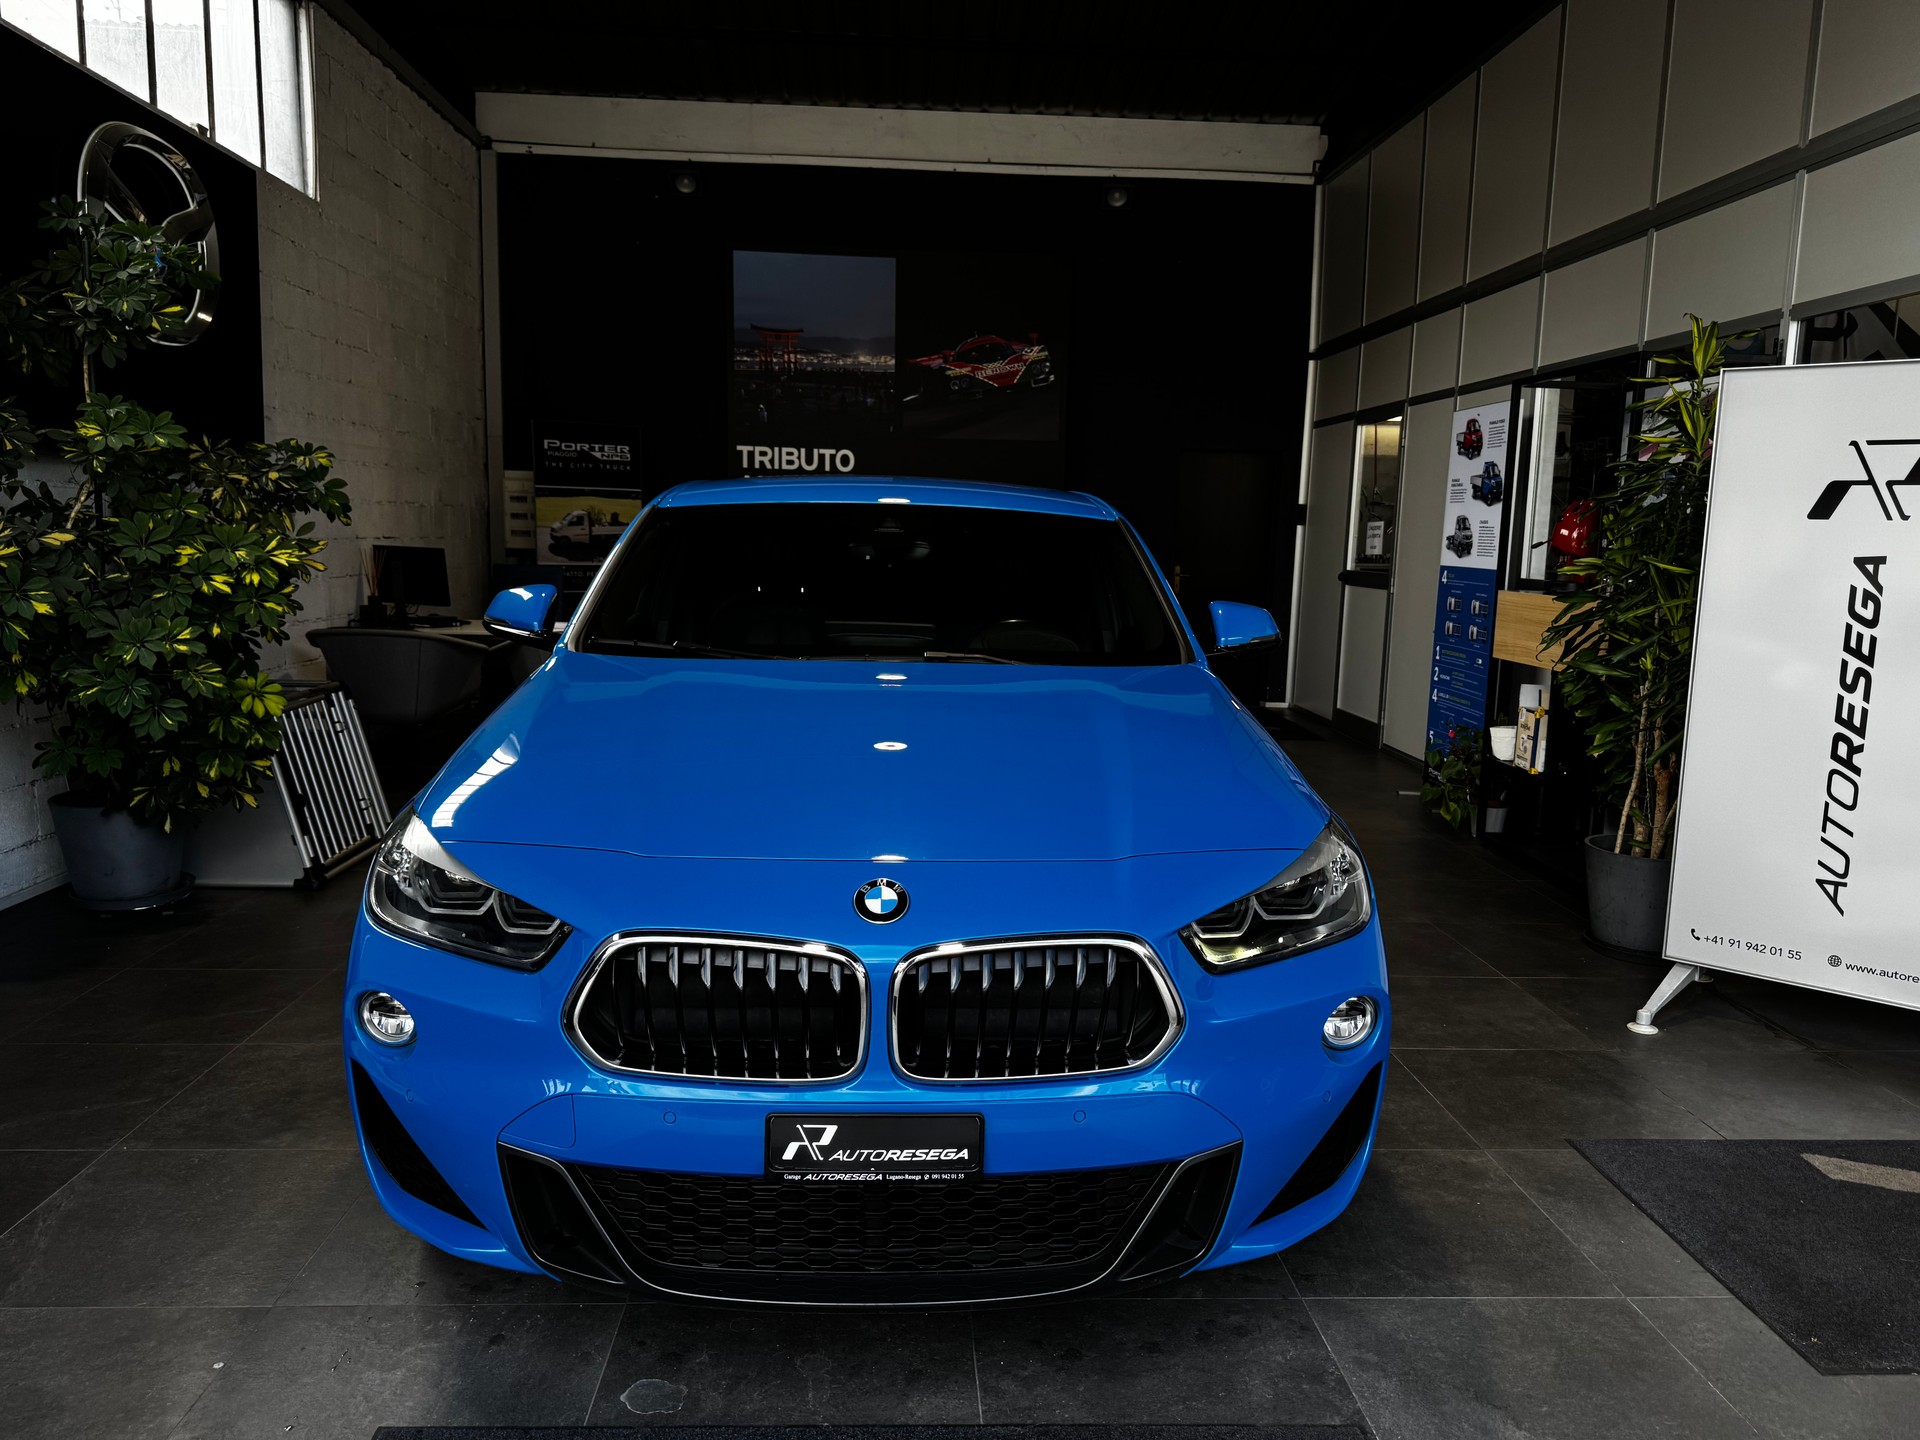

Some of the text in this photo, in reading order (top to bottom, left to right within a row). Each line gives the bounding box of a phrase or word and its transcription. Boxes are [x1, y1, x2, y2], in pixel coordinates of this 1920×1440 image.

[543, 439, 630, 454] PORTER
[570, 462, 594, 470] CITY
[599, 463, 631, 471] TRUCK
[736, 445, 856, 473] TRIBUTO
[1441, 570, 1448, 585] 4
[1435, 645, 1440, 660] 1
[1433, 666, 1439, 681] 2
[1815, 555, 1888, 918] AUTORESEGA
[1704, 935, 1802, 961] +41 91 942 01 55
[828, 1148, 969, 1162] AUTORESEGA
[803, 1173, 883, 1181] AUTORESEGA
